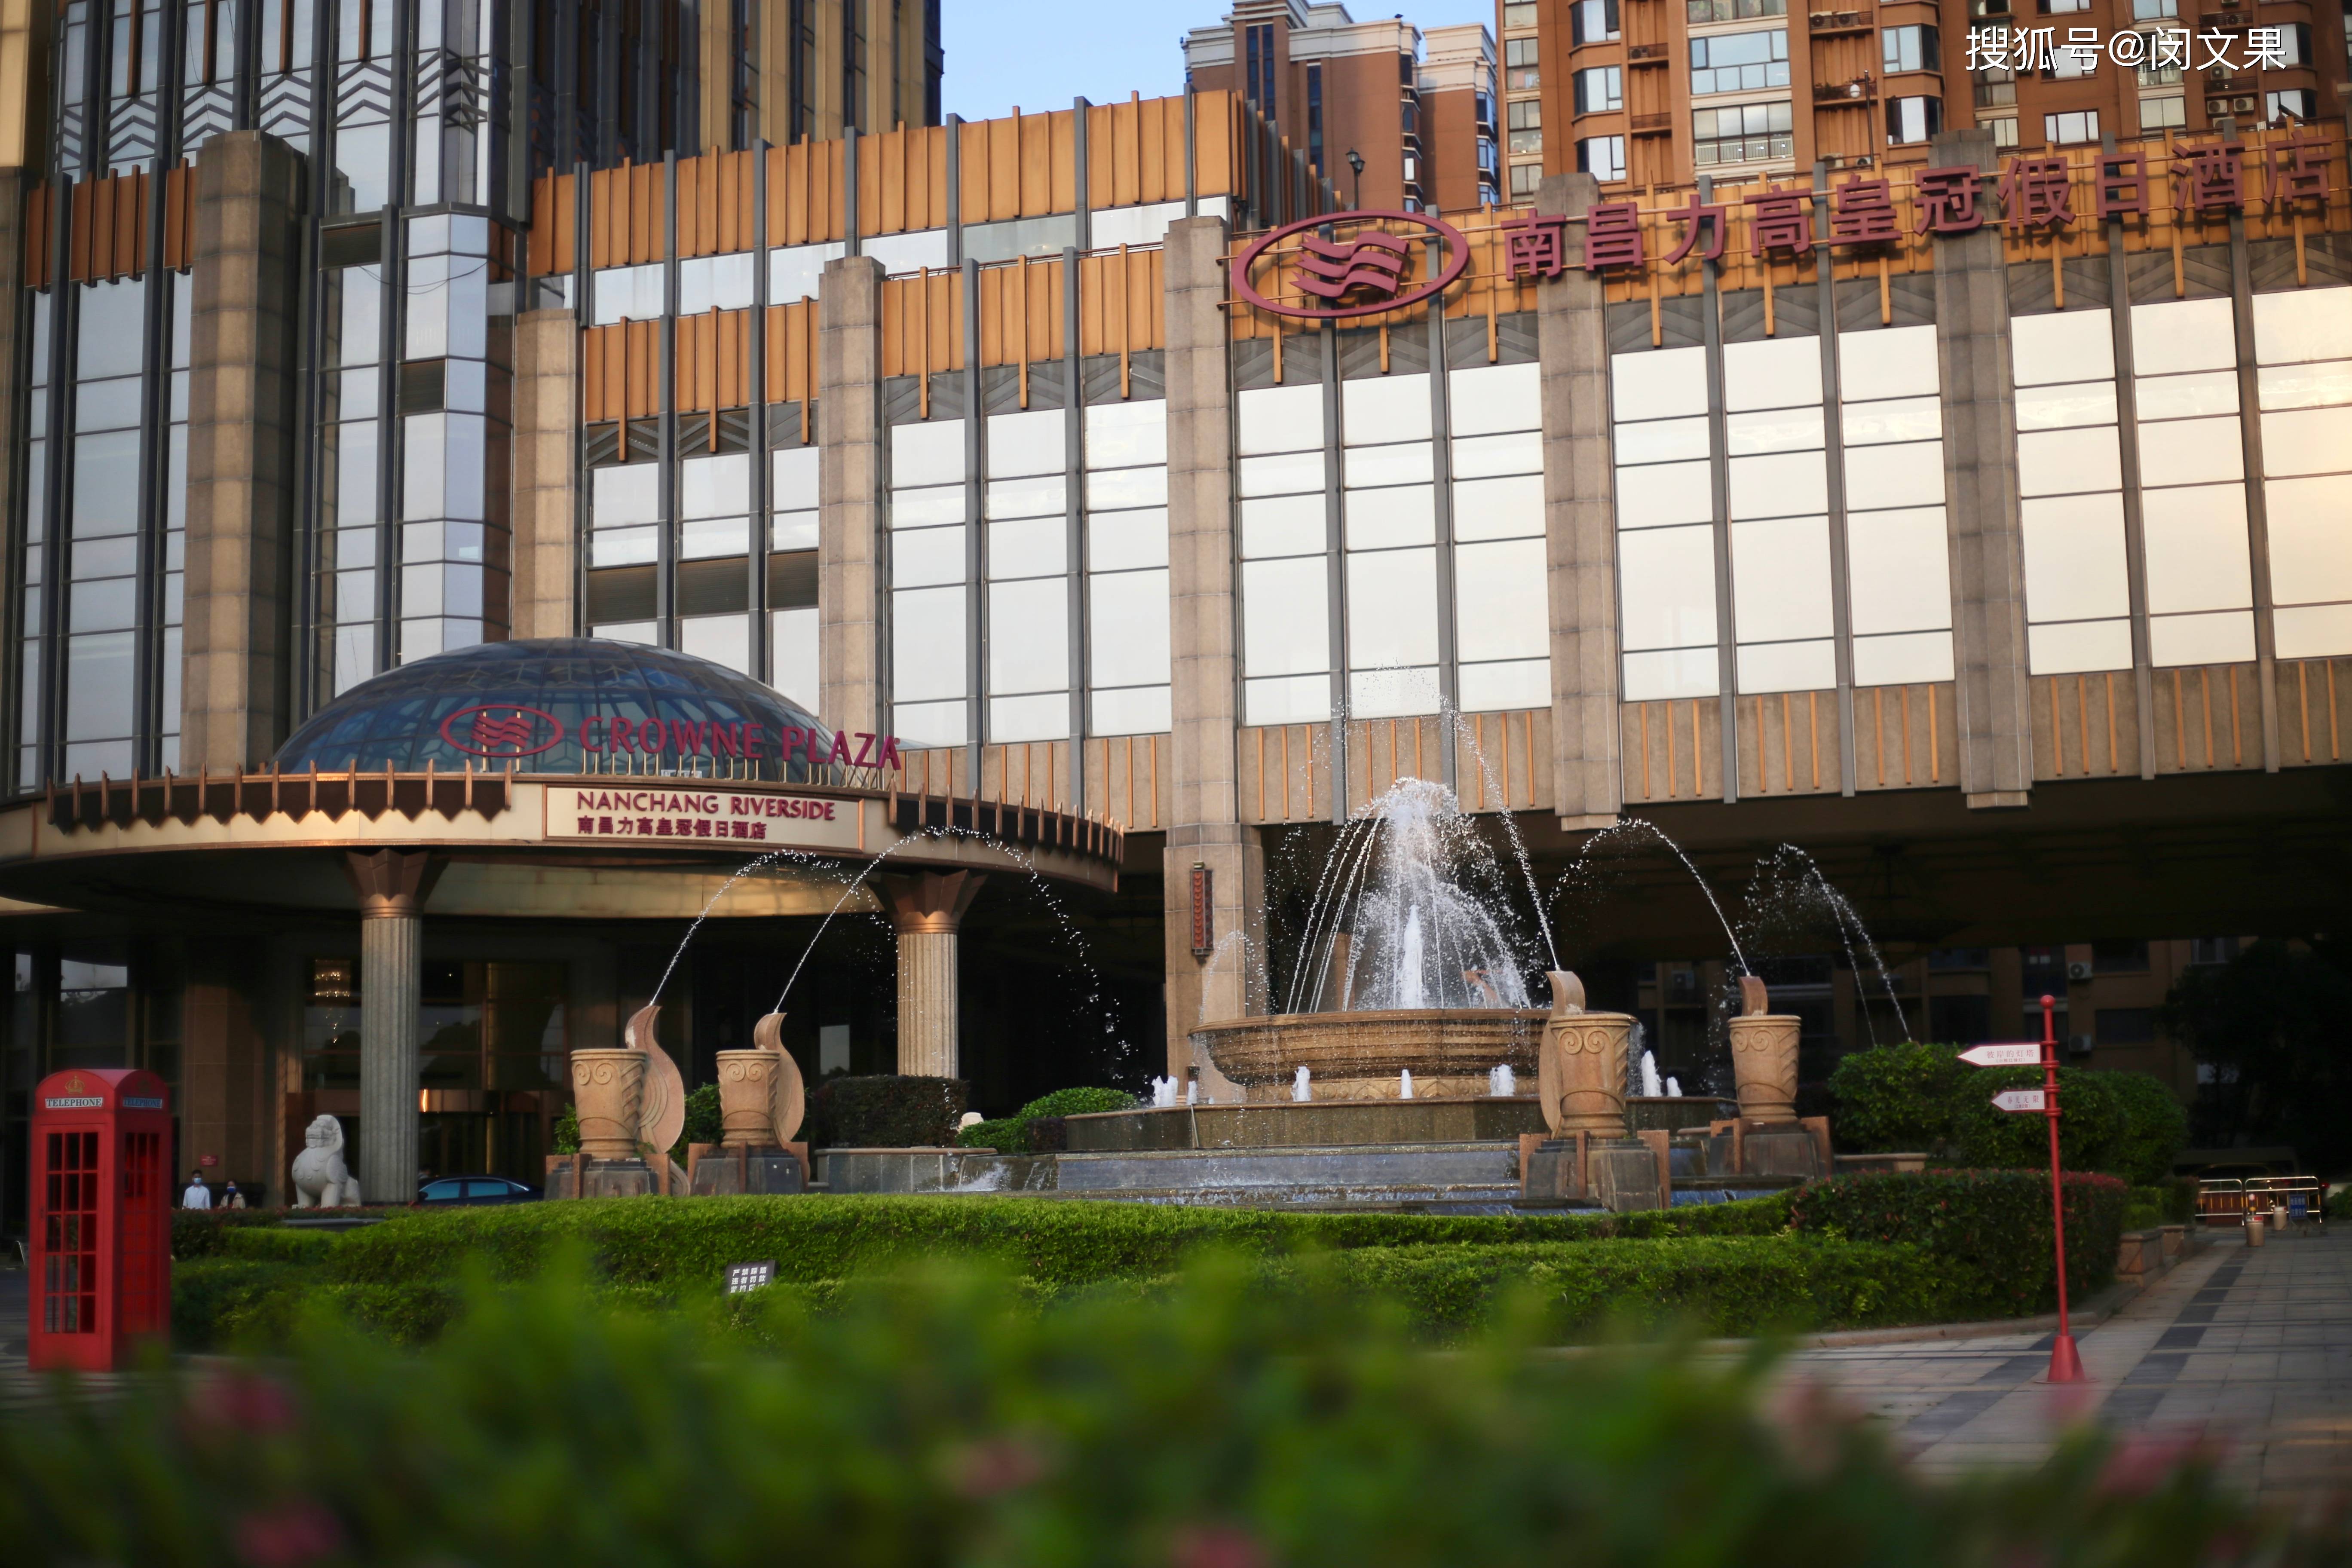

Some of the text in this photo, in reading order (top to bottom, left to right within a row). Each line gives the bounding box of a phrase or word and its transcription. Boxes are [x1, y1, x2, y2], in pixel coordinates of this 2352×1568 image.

[1501, 130, 2331, 281] 南昌力高皇冠假日酒店
[579, 716, 763, 759] CROWNE
[577, 791, 836, 821] NANCHANG RIVERSIDE
[578, 815, 767, 839] 南昌力高皇冠假日酒店
[1987, 1049, 2034, 1059] 彼岸的灯塔
[46, 1098, 101, 1107] TELEPHONE
[124, 1099, 161, 1108] TELEPHONE
[732, 1267, 767, 1277] 严禁踩踏
[732, 1275, 766, 1285] 违者罚款
